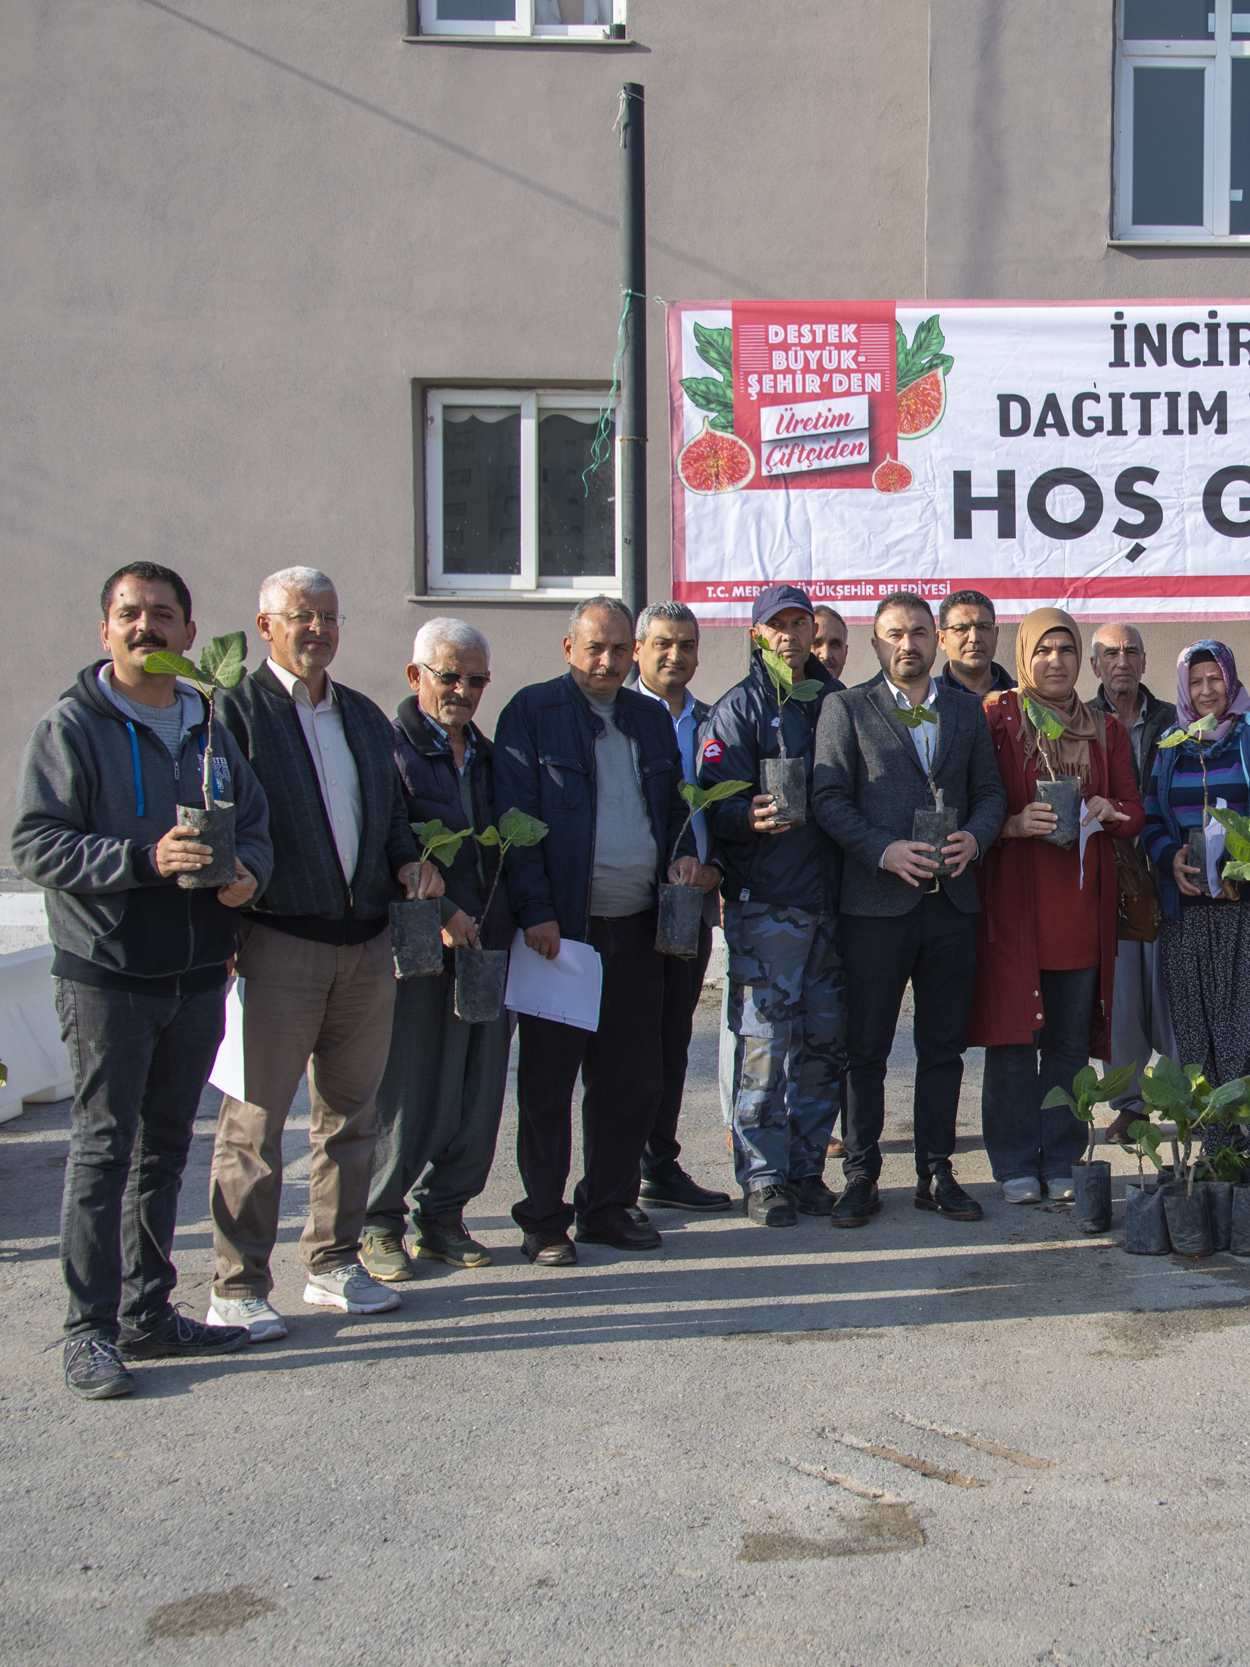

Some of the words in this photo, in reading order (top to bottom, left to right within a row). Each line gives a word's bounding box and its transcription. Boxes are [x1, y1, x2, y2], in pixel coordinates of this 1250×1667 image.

[768, 323, 858, 344] DESTEK
[772, 346, 866, 370] BÜYÜK-
[747, 370, 882, 401] ŞEHİR'DEN
[775, 407, 854, 436] Üretim
[765, 437, 867, 474] Çiftçiden
[953, 466, 1164, 563] HOŞ
[706, 586, 729, 598] T.C.
